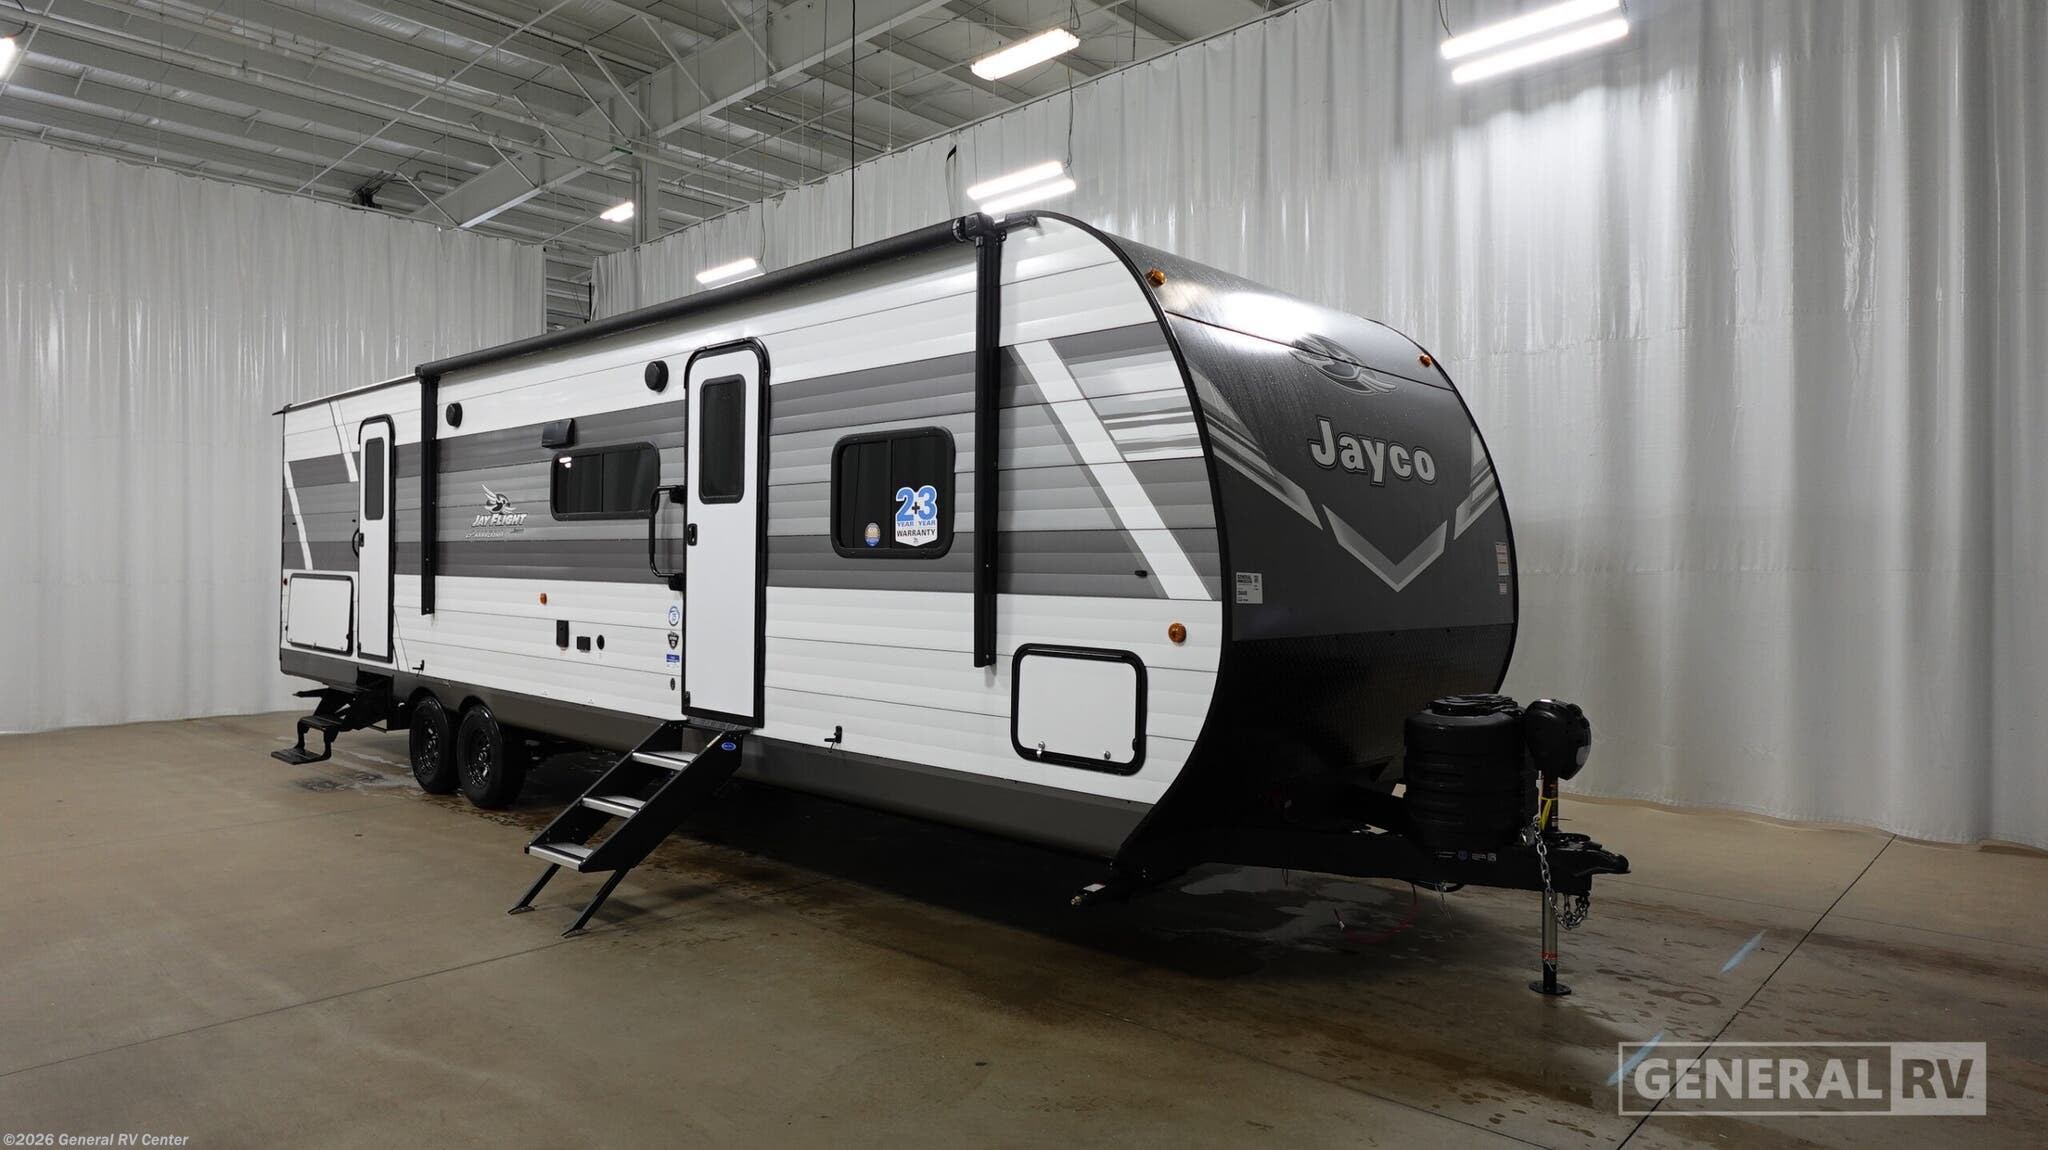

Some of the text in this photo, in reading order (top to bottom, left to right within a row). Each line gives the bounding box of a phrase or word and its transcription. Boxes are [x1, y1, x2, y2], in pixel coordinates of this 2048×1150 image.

[1307, 416, 1436, 487] Jayco
[472, 513, 528, 526] JAY FLIGHT
[896, 528, 936, 537] WARRANTY
